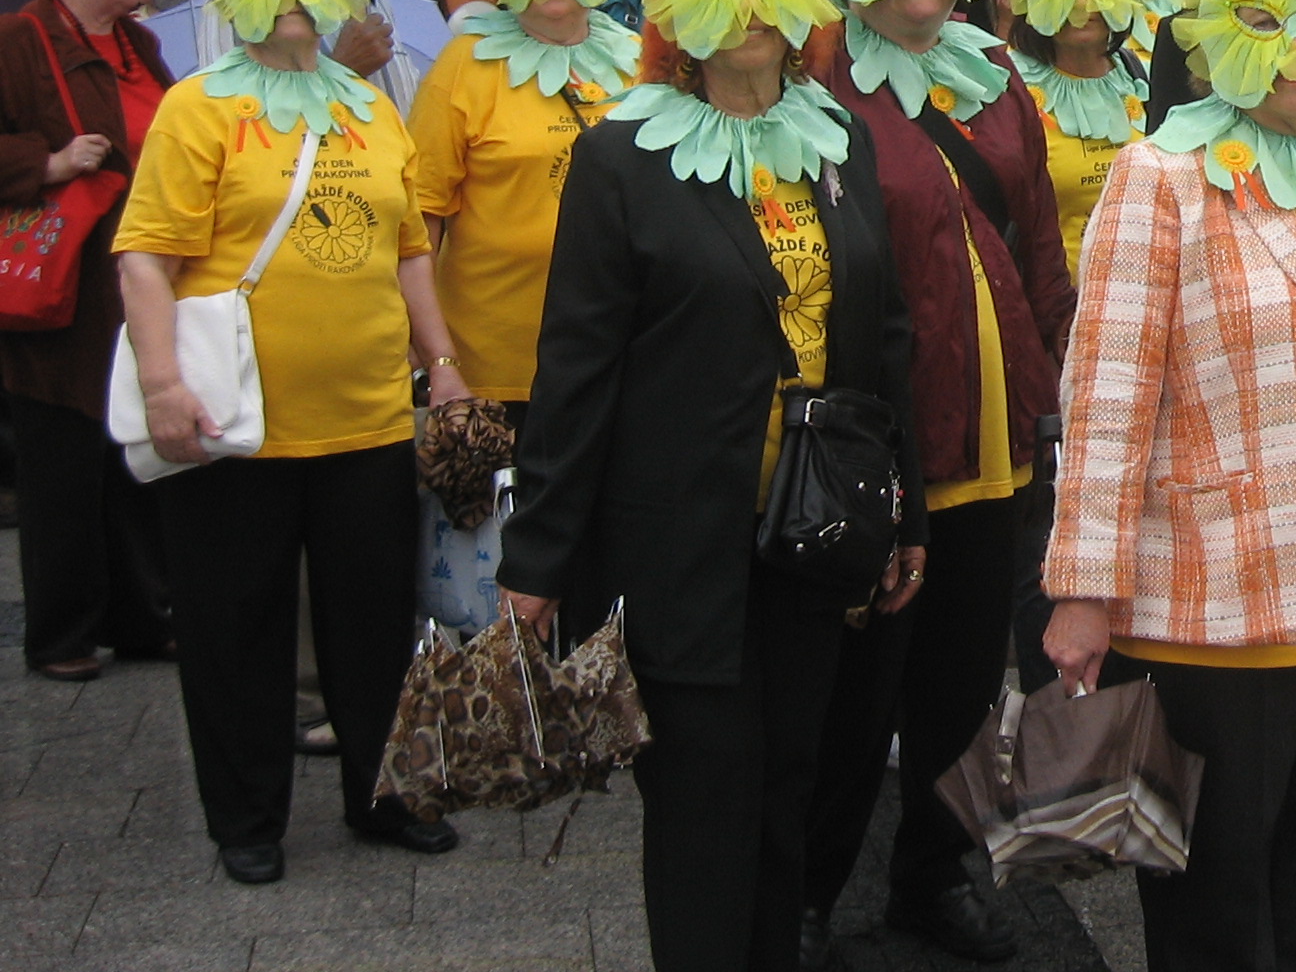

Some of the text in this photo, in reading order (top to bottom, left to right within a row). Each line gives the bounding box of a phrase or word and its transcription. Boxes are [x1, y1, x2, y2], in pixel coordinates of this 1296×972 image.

[548, 125, 577, 133] PROTI
[331, 159, 354, 168] DEN
[1081, 175, 1107, 185] PROT
[785, 199, 816, 214] DEN
[767, 236, 807, 256] AŽDÉ
